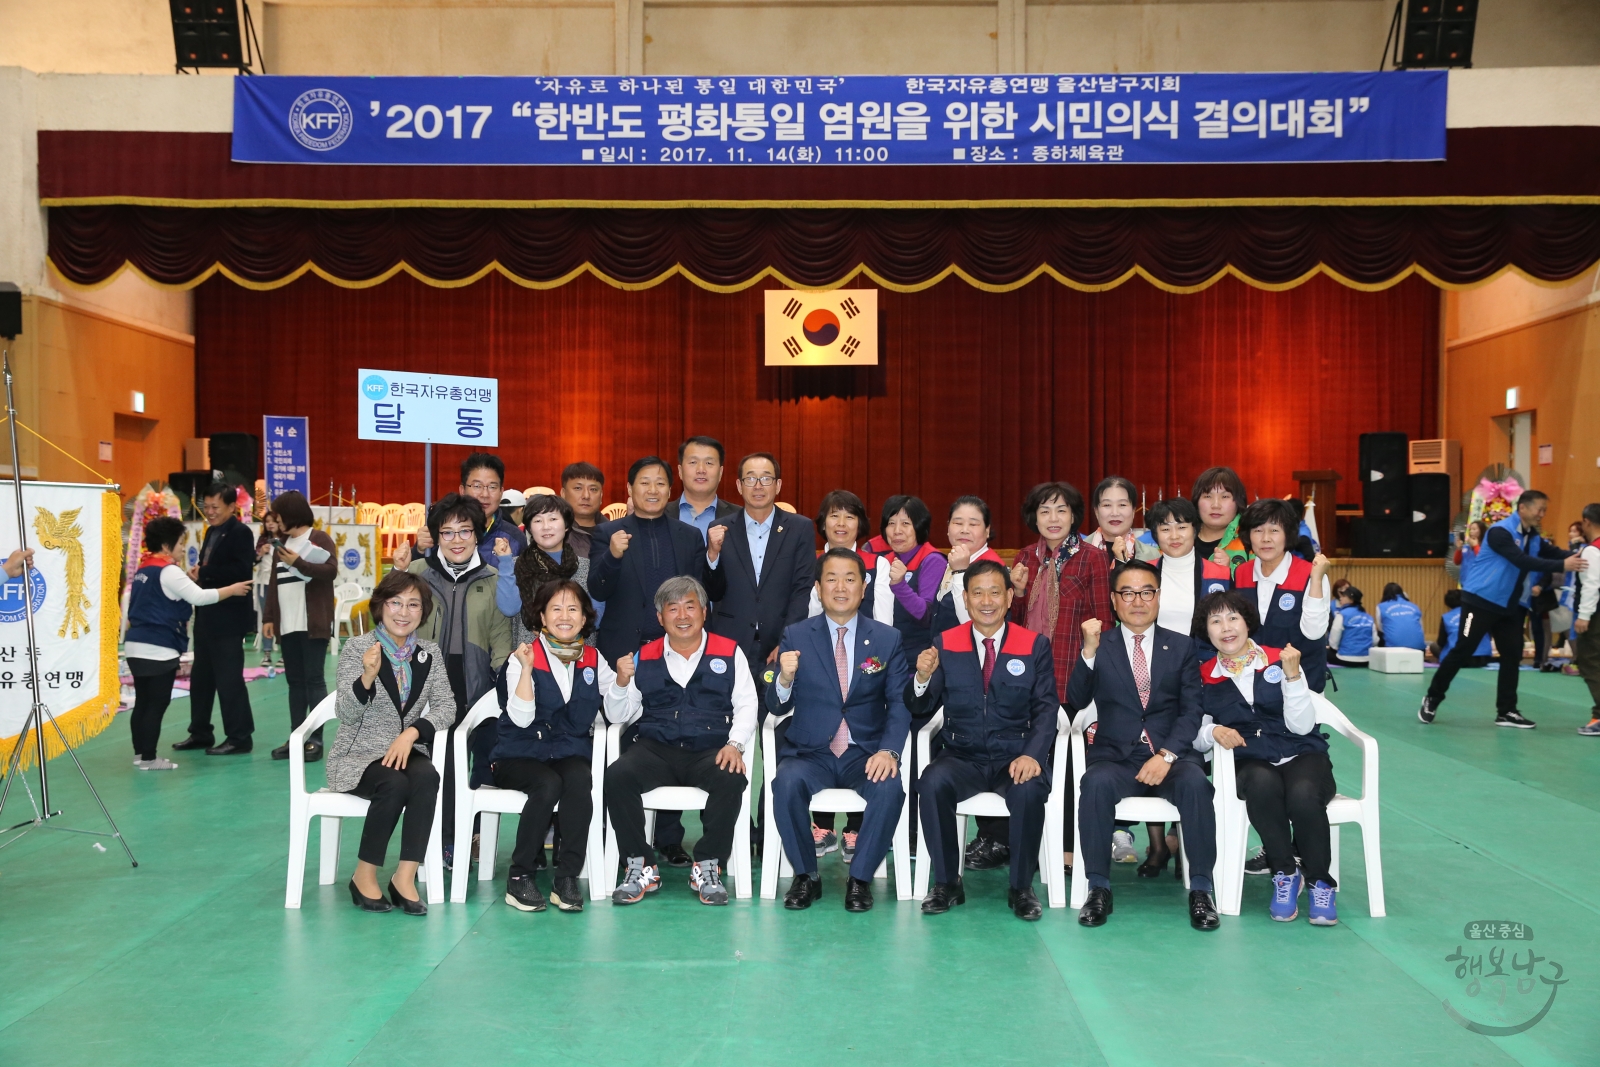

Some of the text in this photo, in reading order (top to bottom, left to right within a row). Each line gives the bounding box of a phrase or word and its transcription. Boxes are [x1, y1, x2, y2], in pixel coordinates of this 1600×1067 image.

[618, 77, 685, 96] 하나된
[695, 77, 737, 96] 통일
[905, 76, 1180, 94] 한국자유총연맹 울산남구지회
[302, 113, 339, 129] KFF
[658, 102, 805, 142] 평화통일
[819, 101, 931, 141] 염원을
[943, 101, 1019, 141] 위한
[1028, 100, 1179, 141] 시민의식
[660, 148, 713, 163] 2017.
[727, 148, 753, 163] 11.
[766, 147, 822, 164] 14(화)
[835, 147, 889, 162] 11:00
[1031, 146, 1124, 162] 종하체육관
[366, 384, 384, 393] KFF
[390, 382, 493, 403] 한국자유총연맹
